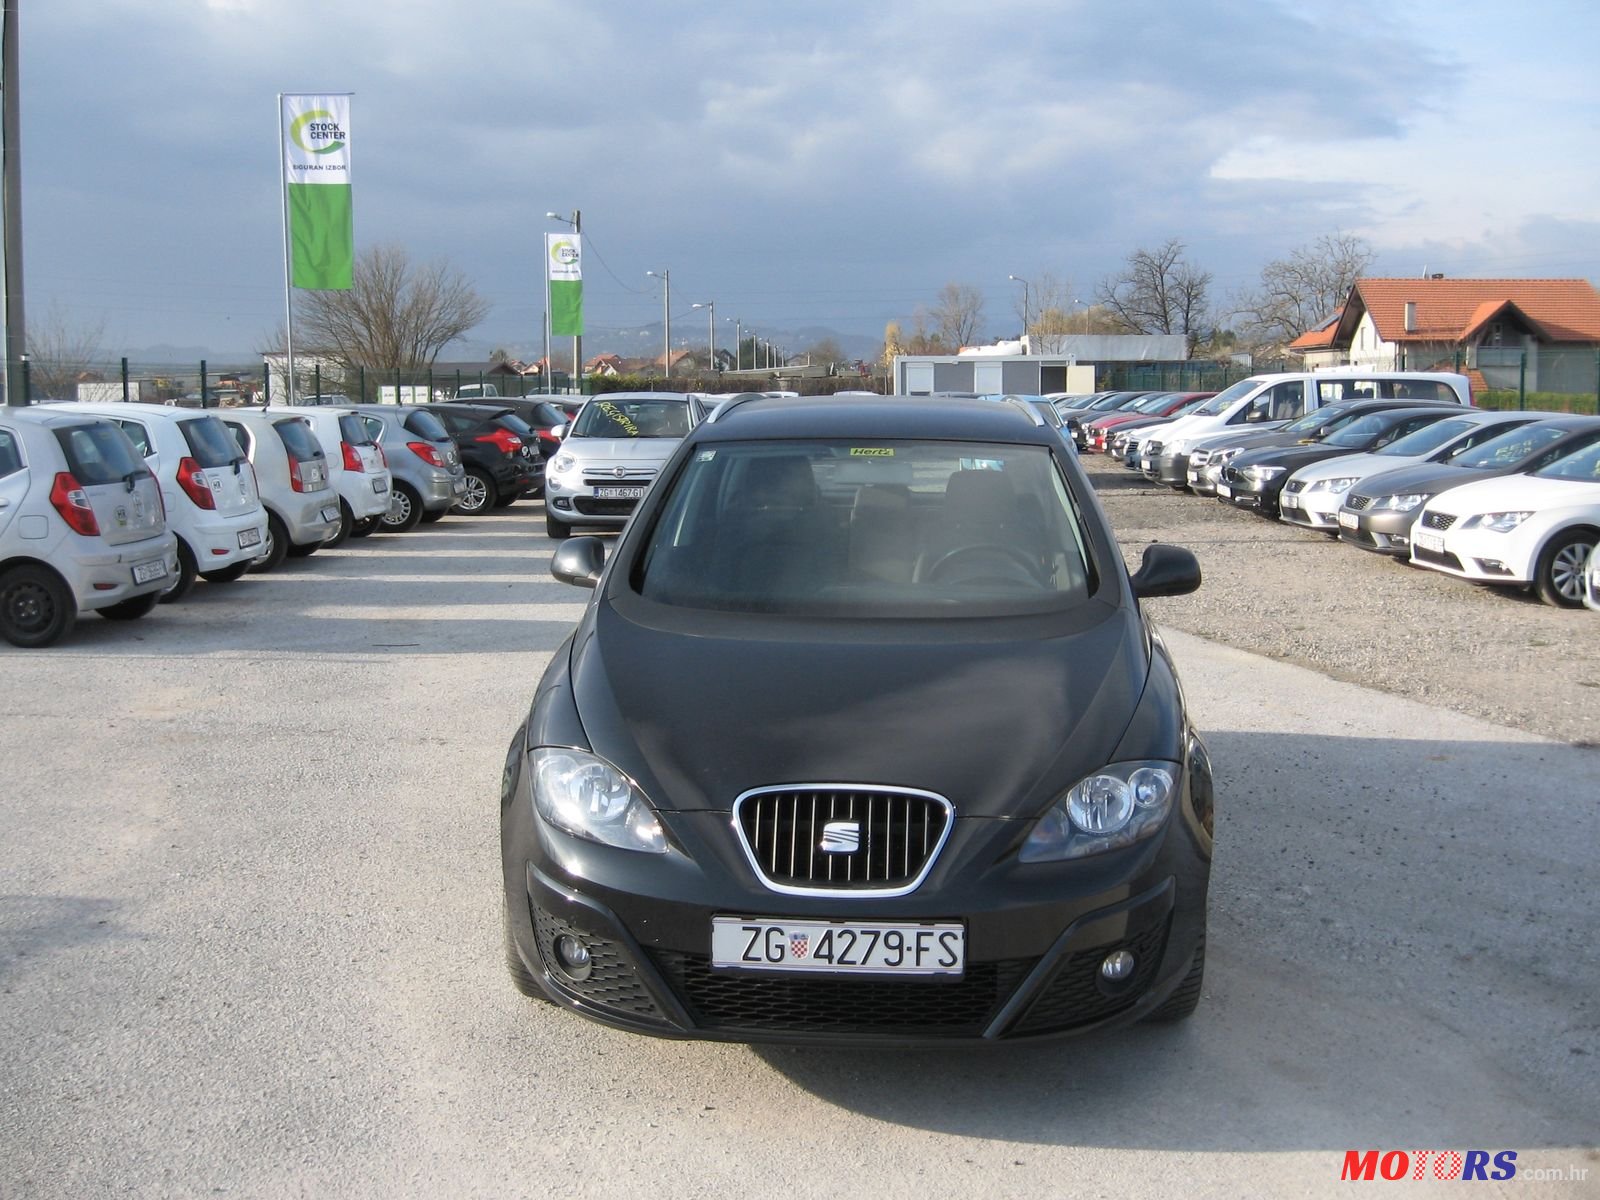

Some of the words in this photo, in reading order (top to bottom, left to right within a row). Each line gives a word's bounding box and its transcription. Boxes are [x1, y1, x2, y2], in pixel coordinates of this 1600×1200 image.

[310, 123, 340, 131] STOCK
[310, 131, 346, 140] CENTER
[742, 927, 785, 962] ZG
